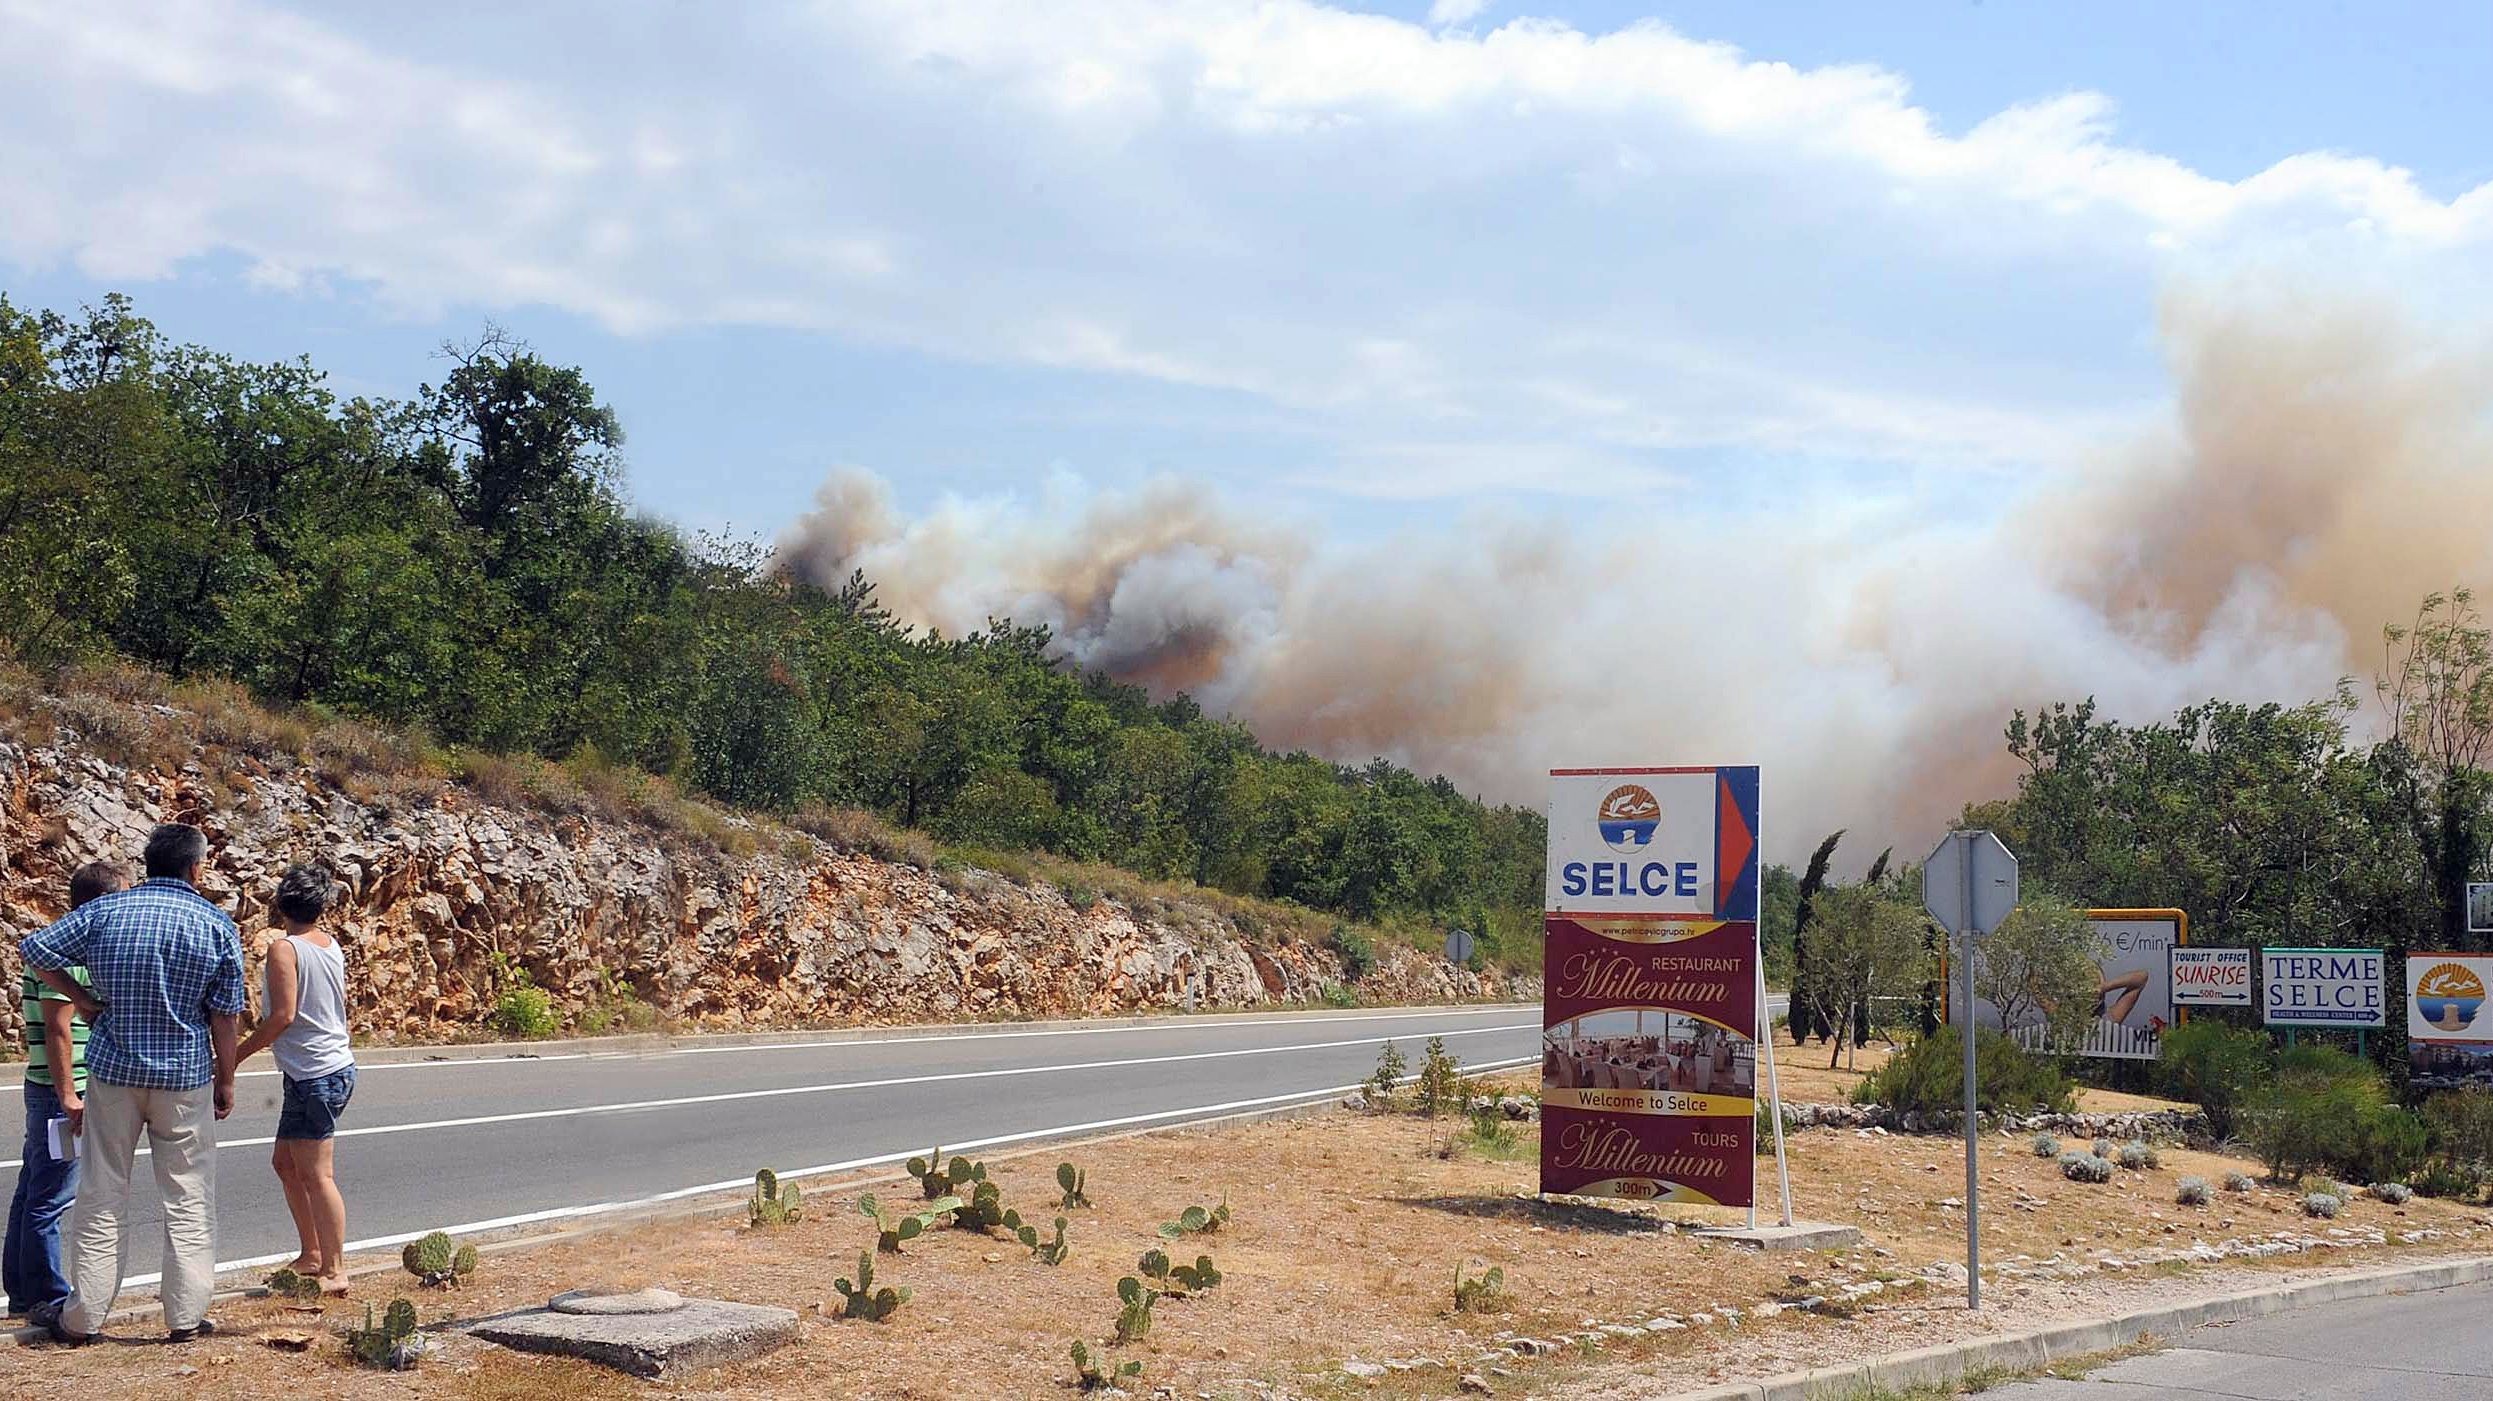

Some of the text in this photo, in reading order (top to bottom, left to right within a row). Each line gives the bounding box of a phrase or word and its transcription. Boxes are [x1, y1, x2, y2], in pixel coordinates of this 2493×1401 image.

[1562, 862, 1697, 896] SELCE
[1652, 957, 1742, 972] RESTAURANT
[2174, 953, 2248, 963] TOURIST OFFICE
[2269, 957, 2379, 980] TERME
[1556, 953, 1730, 1002] Millenium
[2175, 965, 2247, 986] SUNRISE
[2269, 984, 2380, 1008] SELCE
[1578, 1091, 1707, 1112] Welcome to Selce
[1554, 1123, 1728, 1178] Millenium
[1692, 1132, 1739, 1148] TOURS
[1614, 1181, 1650, 1196] 300m
